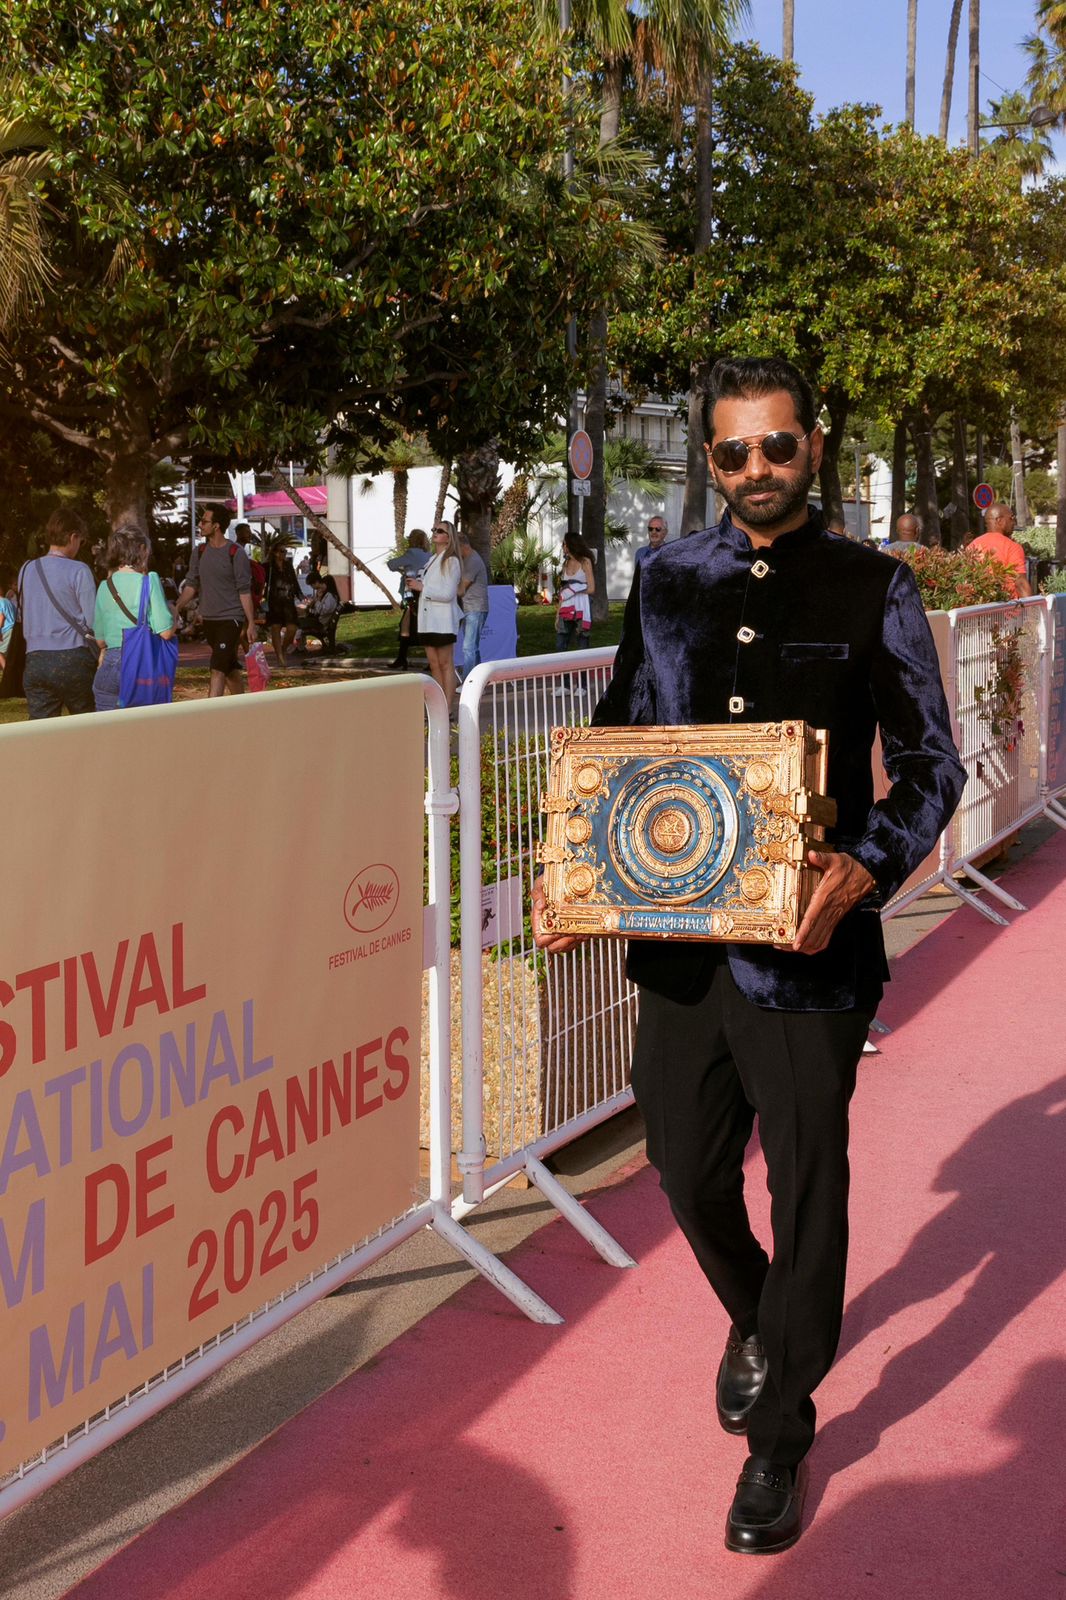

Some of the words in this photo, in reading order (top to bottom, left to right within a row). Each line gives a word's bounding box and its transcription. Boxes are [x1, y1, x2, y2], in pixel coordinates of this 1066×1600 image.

[328, 946, 368, 970] FESTIVAL
[369, 940, 380, 955] DE
[381, 927, 412, 950] CANNES
[0, 1000, 274, 1196] ATIONAL
[84, 1135, 175, 1265] DE
[206, 1026, 410, 1194] CANNES
[28, 1263, 154, 1421] MAI
[187, 1170, 319, 1322] 2025
